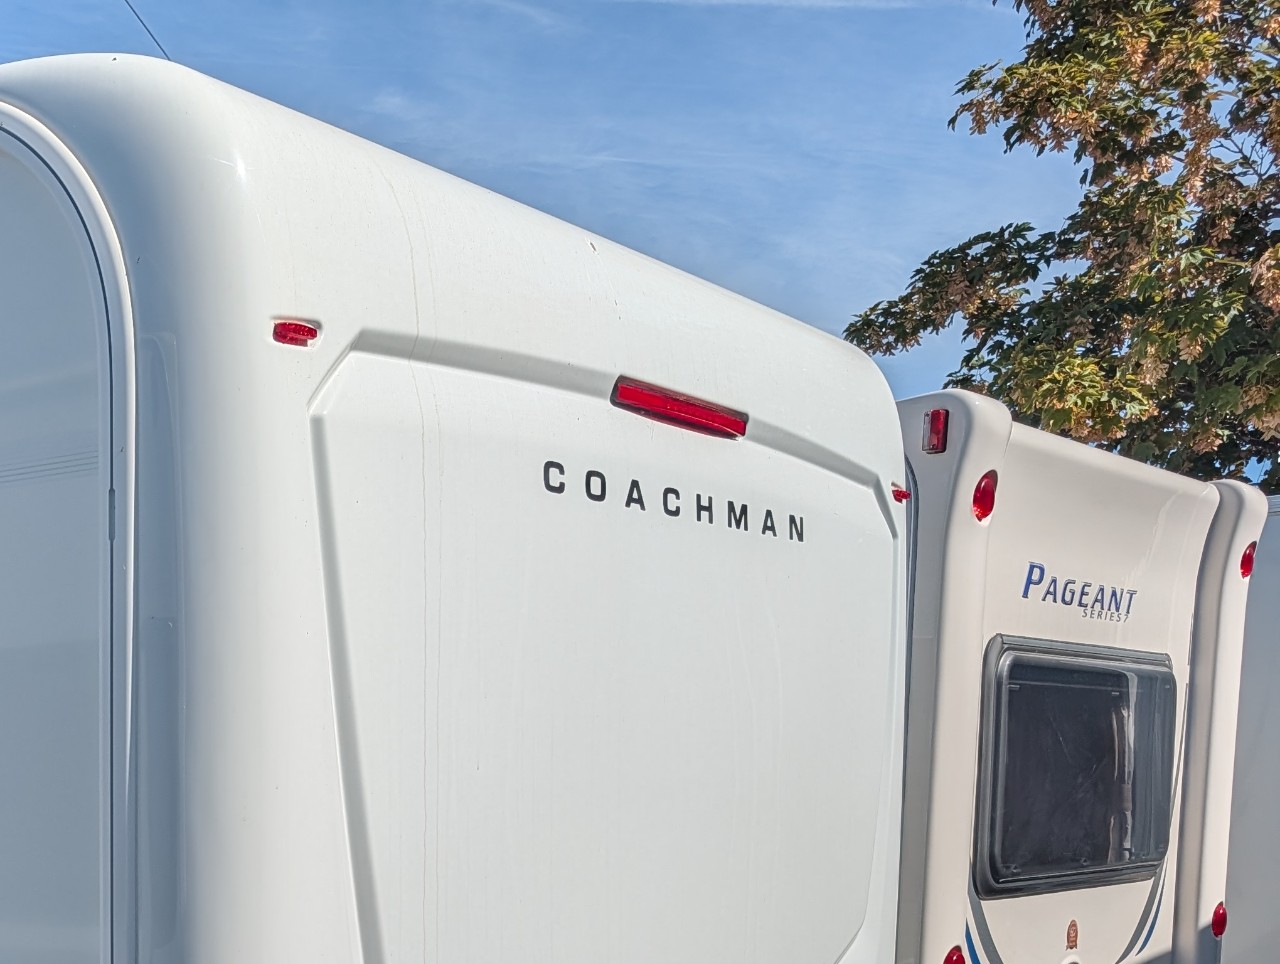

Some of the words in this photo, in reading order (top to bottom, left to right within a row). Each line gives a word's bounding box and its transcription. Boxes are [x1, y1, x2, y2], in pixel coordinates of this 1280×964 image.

[543, 460, 805, 543] COACHMAN
[1022, 561, 1138, 615] PAGEANT
[1082, 608, 1122, 623] SERIES
